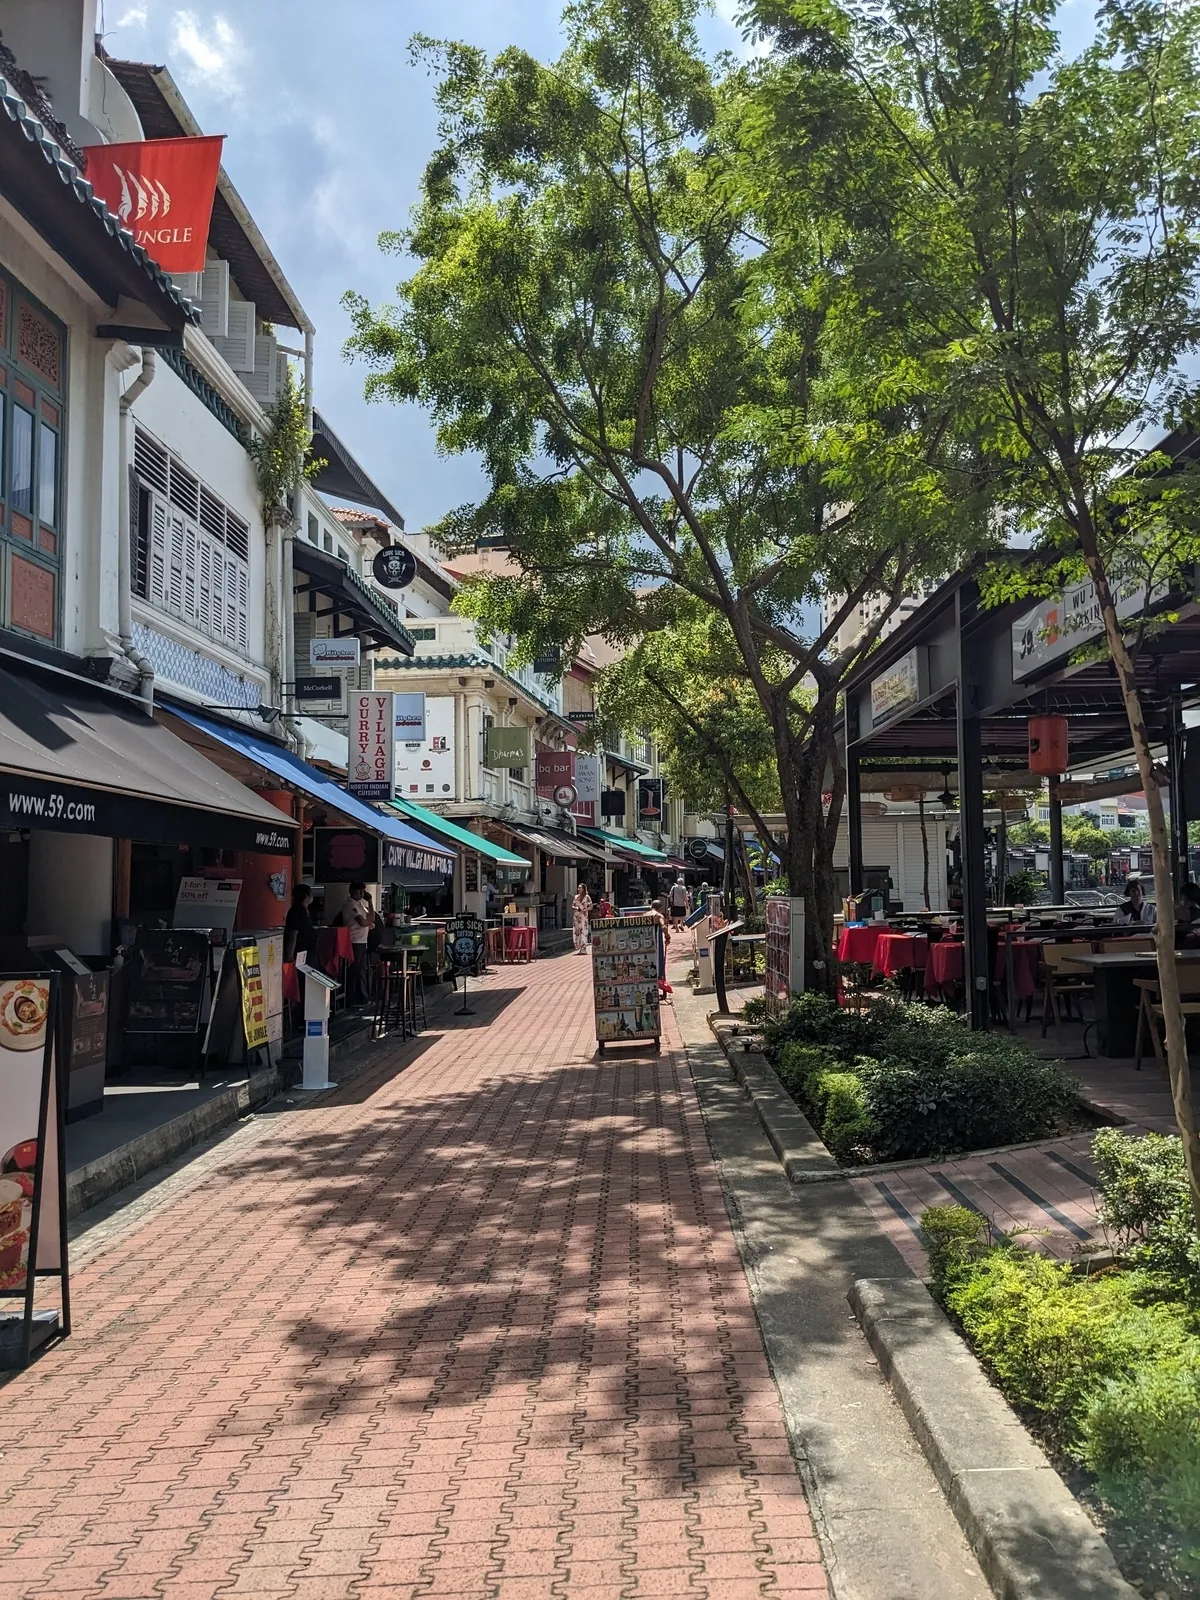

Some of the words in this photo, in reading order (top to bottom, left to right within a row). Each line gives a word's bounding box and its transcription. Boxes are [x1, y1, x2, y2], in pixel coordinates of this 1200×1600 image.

[358, 697, 370, 754] CURRY
[374, 697, 387, 781] VILLAGE
[539, 764, 551, 774] bq
[553, 763, 570, 772] bar
[9, 793, 96, 822] www.59.com
[180, 891, 197, 899] 50%
[197, 892, 209, 900] off
[446, 920, 465, 932] LOVE
[466, 919, 483, 932] SICK
[592, 919, 621, 929] HAPPY
[623, 916, 653, 927] HOURS
[456, 930, 474, 938] TATTOO
